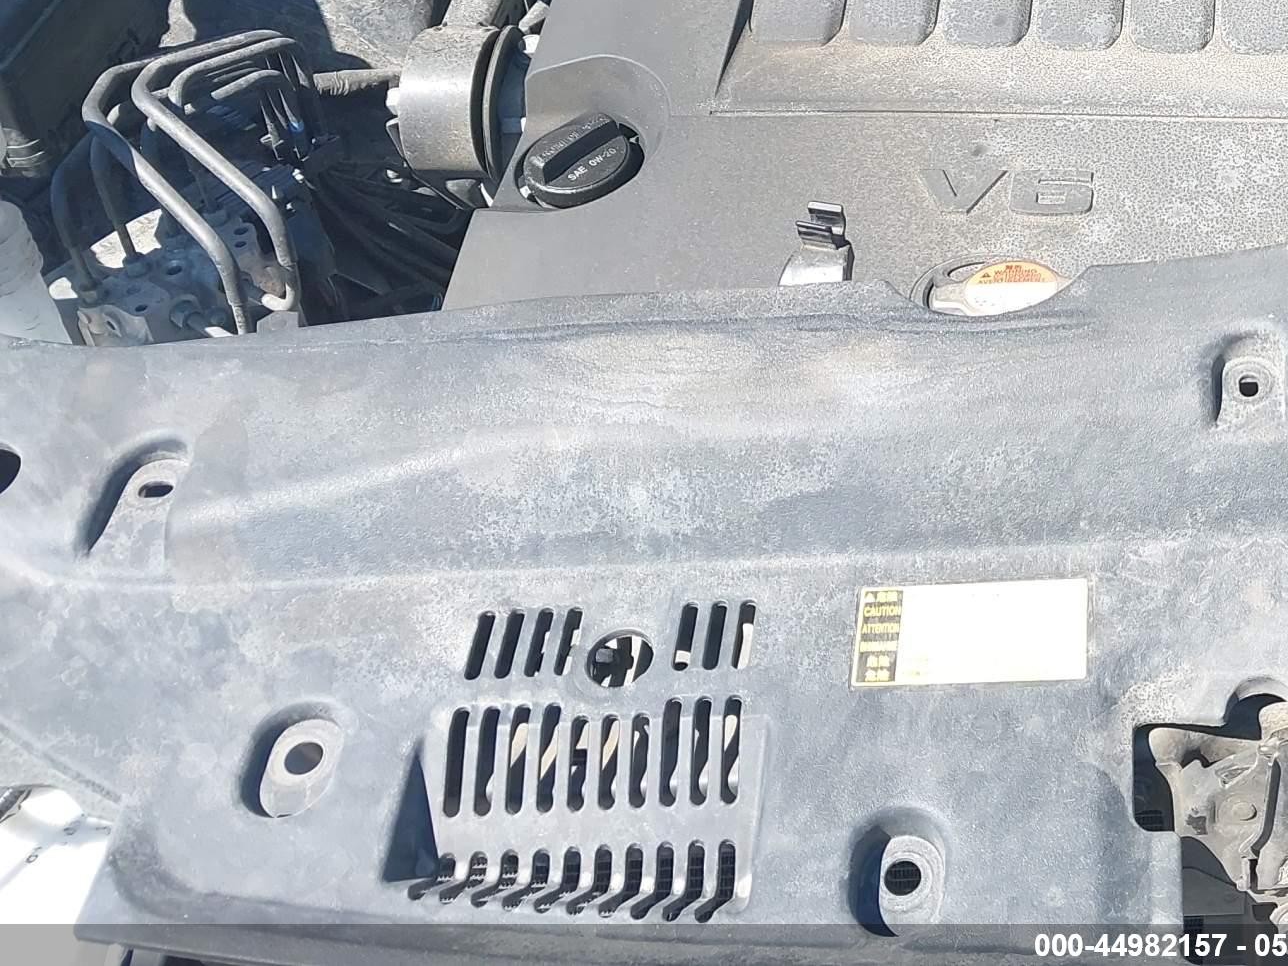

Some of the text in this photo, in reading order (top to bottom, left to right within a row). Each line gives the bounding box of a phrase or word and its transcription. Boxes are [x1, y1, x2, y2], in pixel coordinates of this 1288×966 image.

[567, 165, 588, 181] SAE
[919, 168, 1094, 216] V6
[864, 604, 902, 618] CAUTION
[861, 622, 901, 634] ATTENTION
